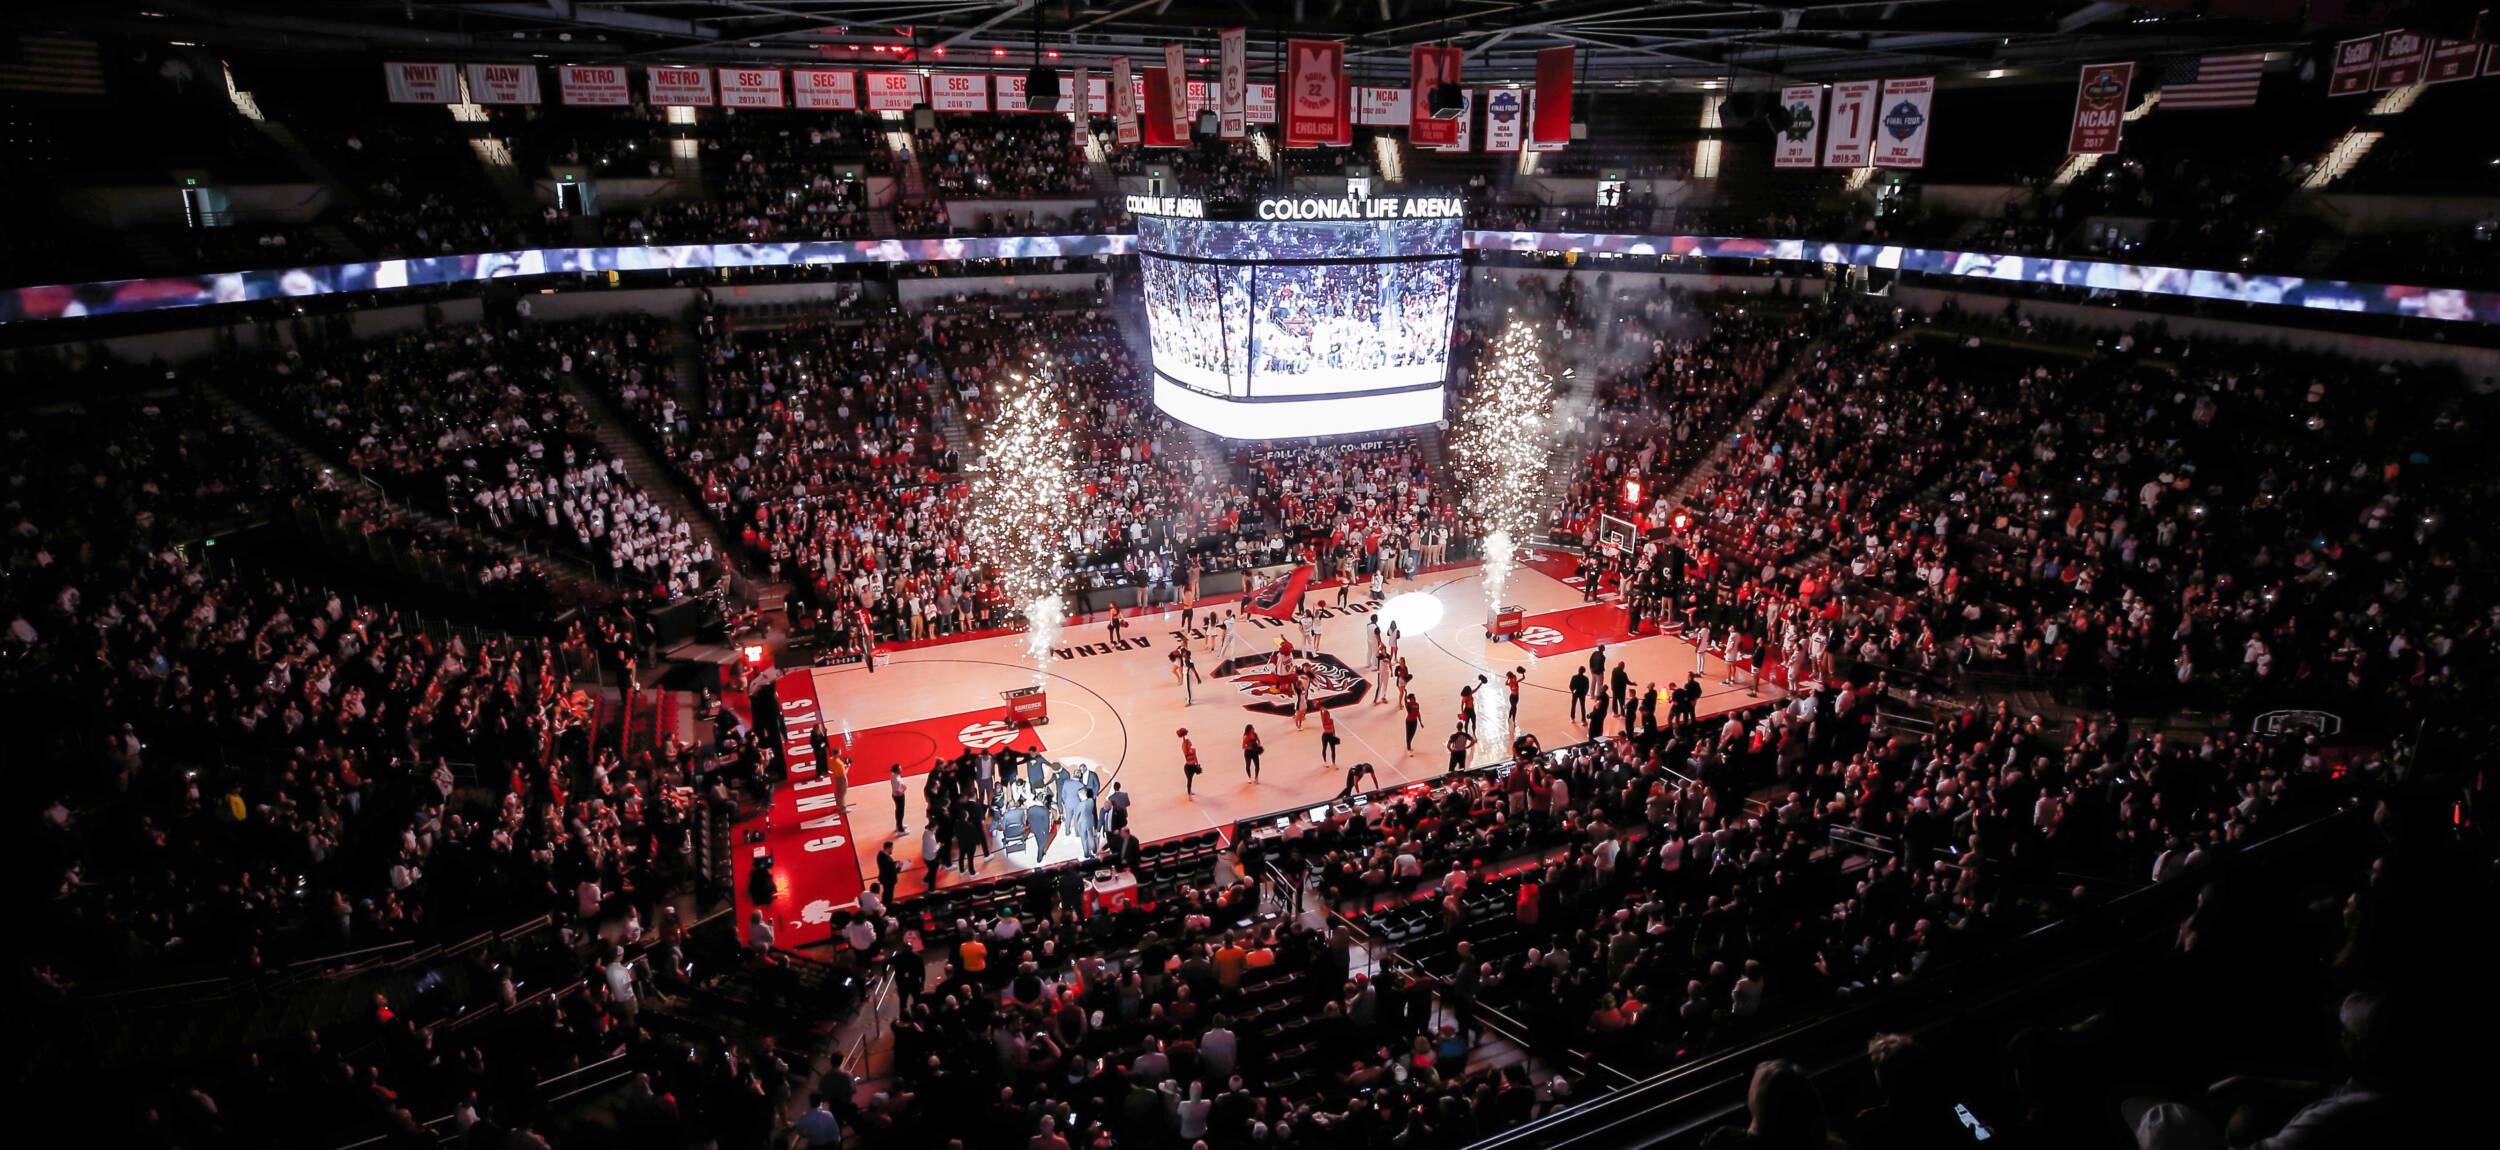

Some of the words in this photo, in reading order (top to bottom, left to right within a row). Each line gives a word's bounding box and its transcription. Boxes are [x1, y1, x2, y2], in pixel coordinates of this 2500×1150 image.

[403, 66, 438, 80] NWIT
[486, 67, 520, 82] AIAW
[572, 70, 615, 83] METRO
[657, 71, 699, 85] METRO
[739, 73, 762, 86] SEC
[813, 74, 835, 87] SEC
[886, 77, 907, 89] SEC
[948, 78, 969, 90] SEC
[1013, 79, 1026, 92] SE
[1189, 84, 1206, 96] SEC
[1309, 84, 1322, 96] 22
[1376, 90, 1399, 101] NCAA
[1491, 104, 1504, 112] FINAL
[1505, 104, 1519, 112] FOUR
[1904, 116, 1920, 125] FOUR
[2079, 110, 2116, 127] NCAA
[1295, 122, 1334, 134] ENGLISH
[2083, 138, 2105, 147] 2017
[1789, 148, 1803, 156] 2017
[1891, 147, 1908, 156] 2022
[1126, 195, 1161, 215] COLONIAL
[1162, 198, 1176, 216] LIFE
[1176, 198, 1203, 218] ARENA
[1259, 198, 1360, 220] COLONIAL
[1366, 198, 1399, 218] LIFE
[1402, 198, 1463, 217] ARENA
[1340, 441, 1383, 453] COKPIT
[1055, 636, 1151, 660] ARENA
[782, 698, 846, 853] GAMECOCKS
